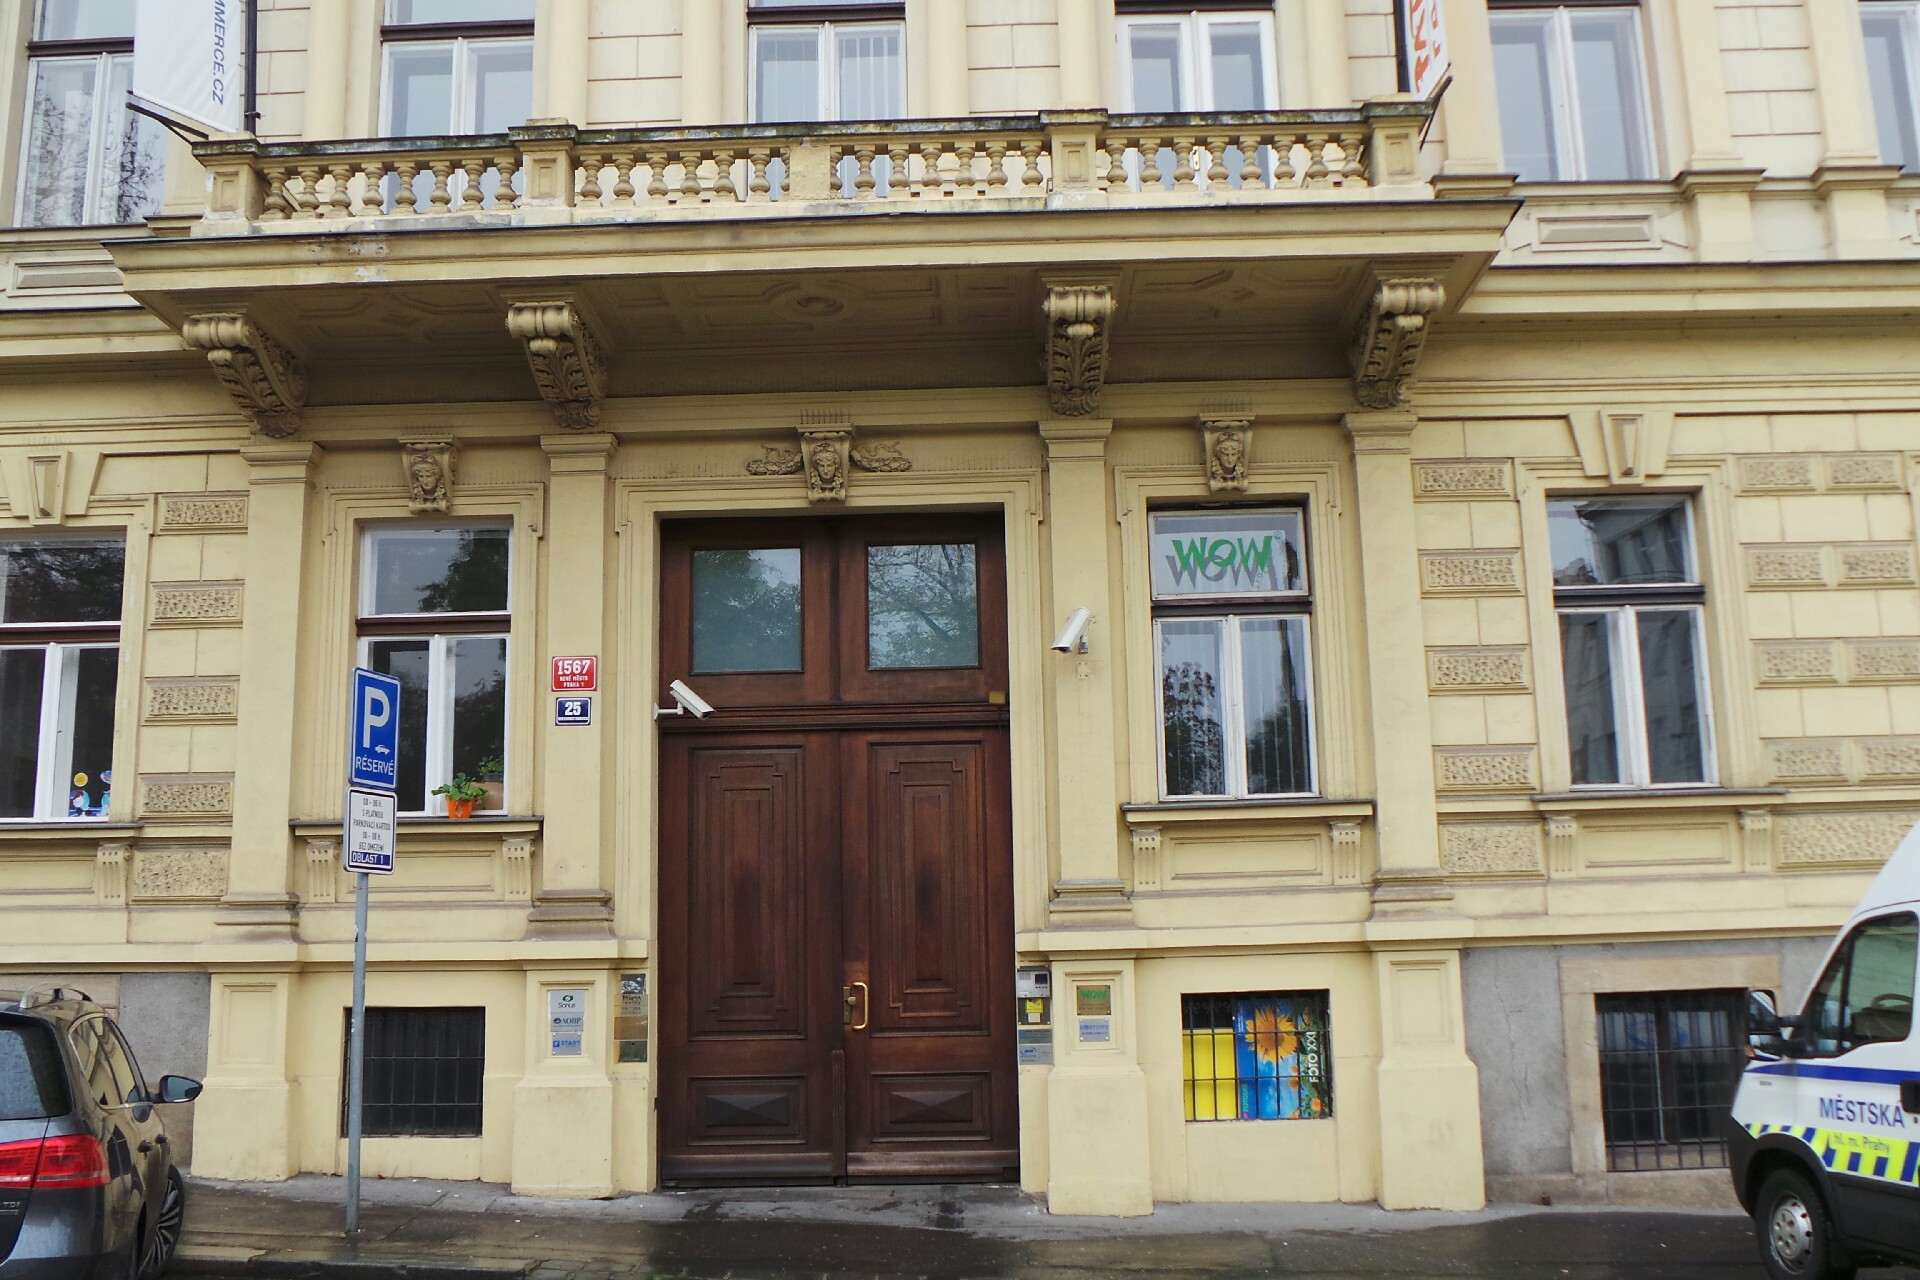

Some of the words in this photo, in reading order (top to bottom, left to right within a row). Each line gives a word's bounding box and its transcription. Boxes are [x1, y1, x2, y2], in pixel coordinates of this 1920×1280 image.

[1172, 536, 1272, 572] WOW
[558, 660, 590, 675] 1567
[363, 686, 390, 748] P
[564, 702, 581, 716] 25
[356, 755, 394, 776] RÉSERVÉ
[366, 810, 383, 818] PLATNOU
[353, 819, 375, 828] PARKOVACÍ
[376, 822, 391, 830] KARTOU
[352, 852, 378, 864] OBLAST
[380, 855, 384, 864] 1
[1080, 990, 1107, 999] WOW
[1306, 1031, 1318, 1051] XXI
[1308, 1053, 1319, 1083] FOTO
[1834, 1132, 1845, 1145] hl.
[1848, 1137, 1860, 1147] m.
[1863, 1136, 1889, 1155] Prahy
